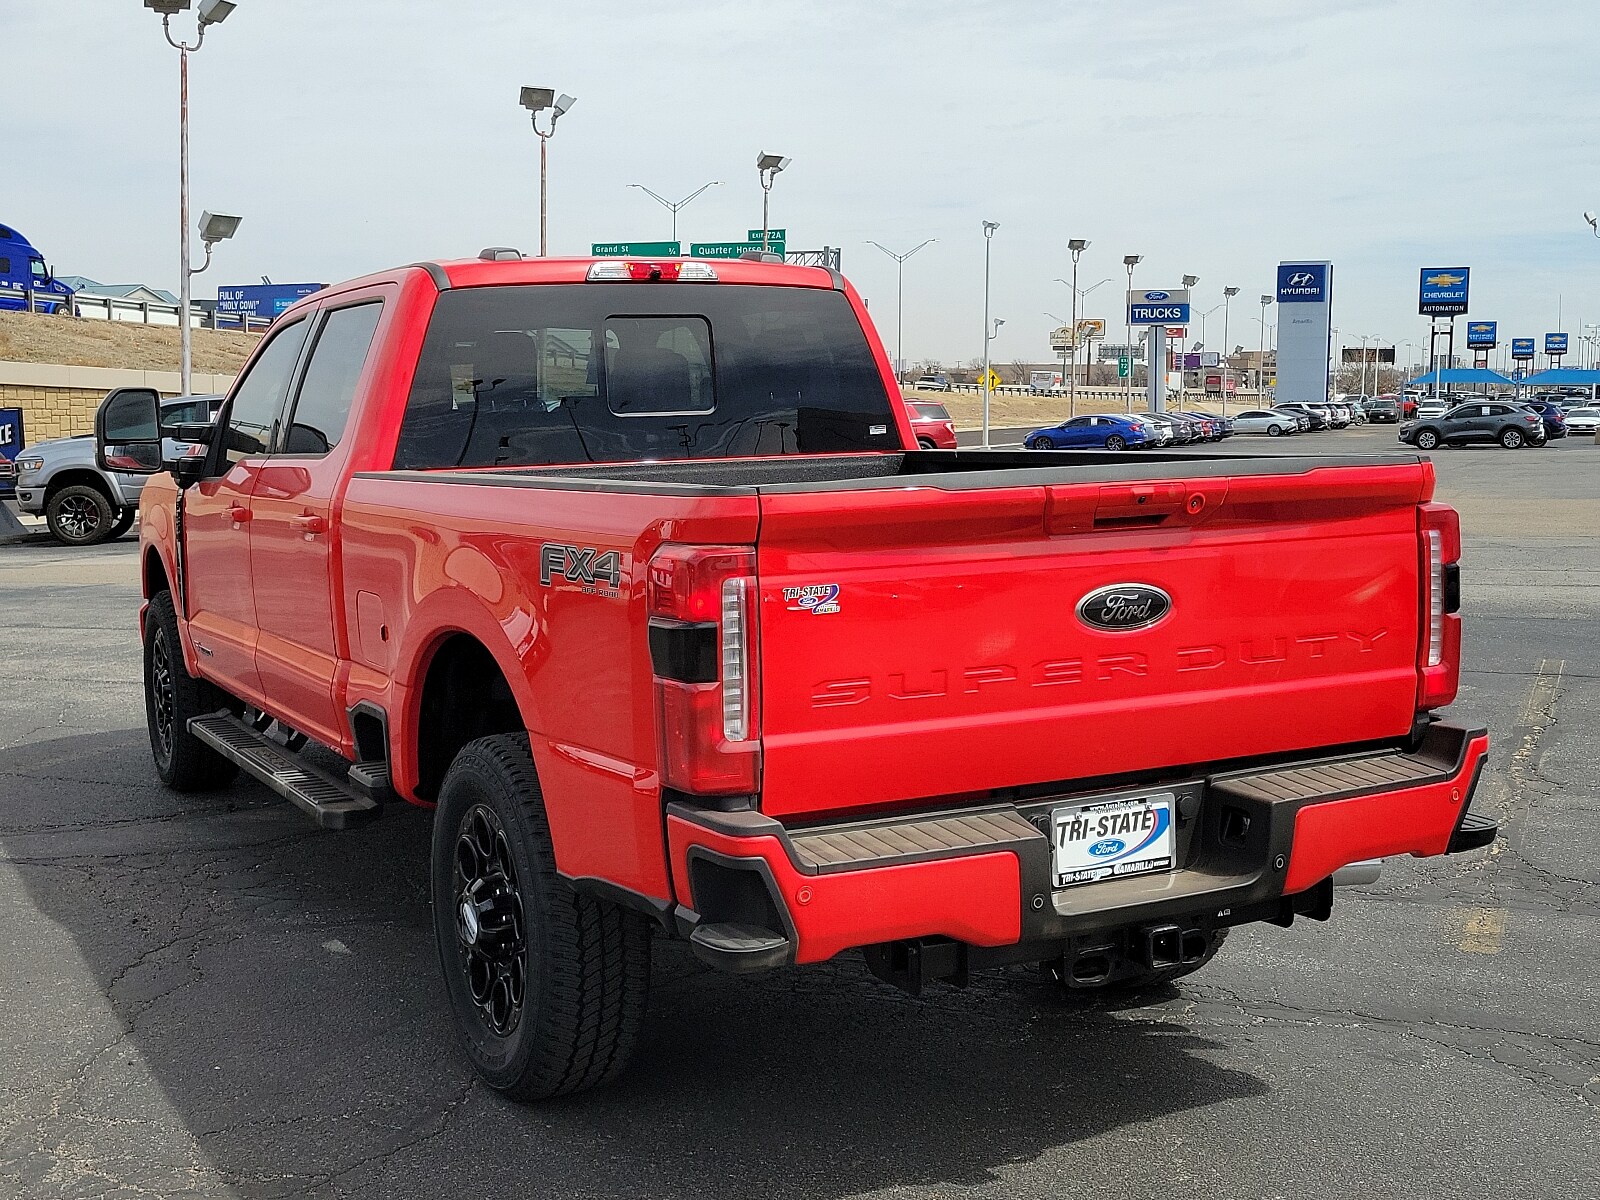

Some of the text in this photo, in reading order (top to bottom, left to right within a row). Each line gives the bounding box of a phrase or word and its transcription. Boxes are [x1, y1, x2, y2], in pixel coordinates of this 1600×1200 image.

[767, 231, 782, 239] 72A
[595, 245, 618, 253] Grand
[698, 245, 733, 255] Quarter
[219, 290, 244, 300] FULL OF
[1148, 292, 1164, 300] Ford
[1280, 287, 1320, 296] HYUNDAI
[1423, 291, 1465, 299] CHEVROLET
[1133, 307, 1181, 319] TRUCKS
[540, 542, 620, 590] FX4
[581, 586, 619, 599] OFF ROAD
[783, 585, 830, 601] TRI-STATE
[1100, 593, 1152, 623] Ford
[811, 627, 1388, 708] SUPER DUTY
[1056, 809, 1153, 850] TRI-STATE
[1095, 841, 1119, 855] Ford
[1061, 870, 1096, 885] TRI-STATE
